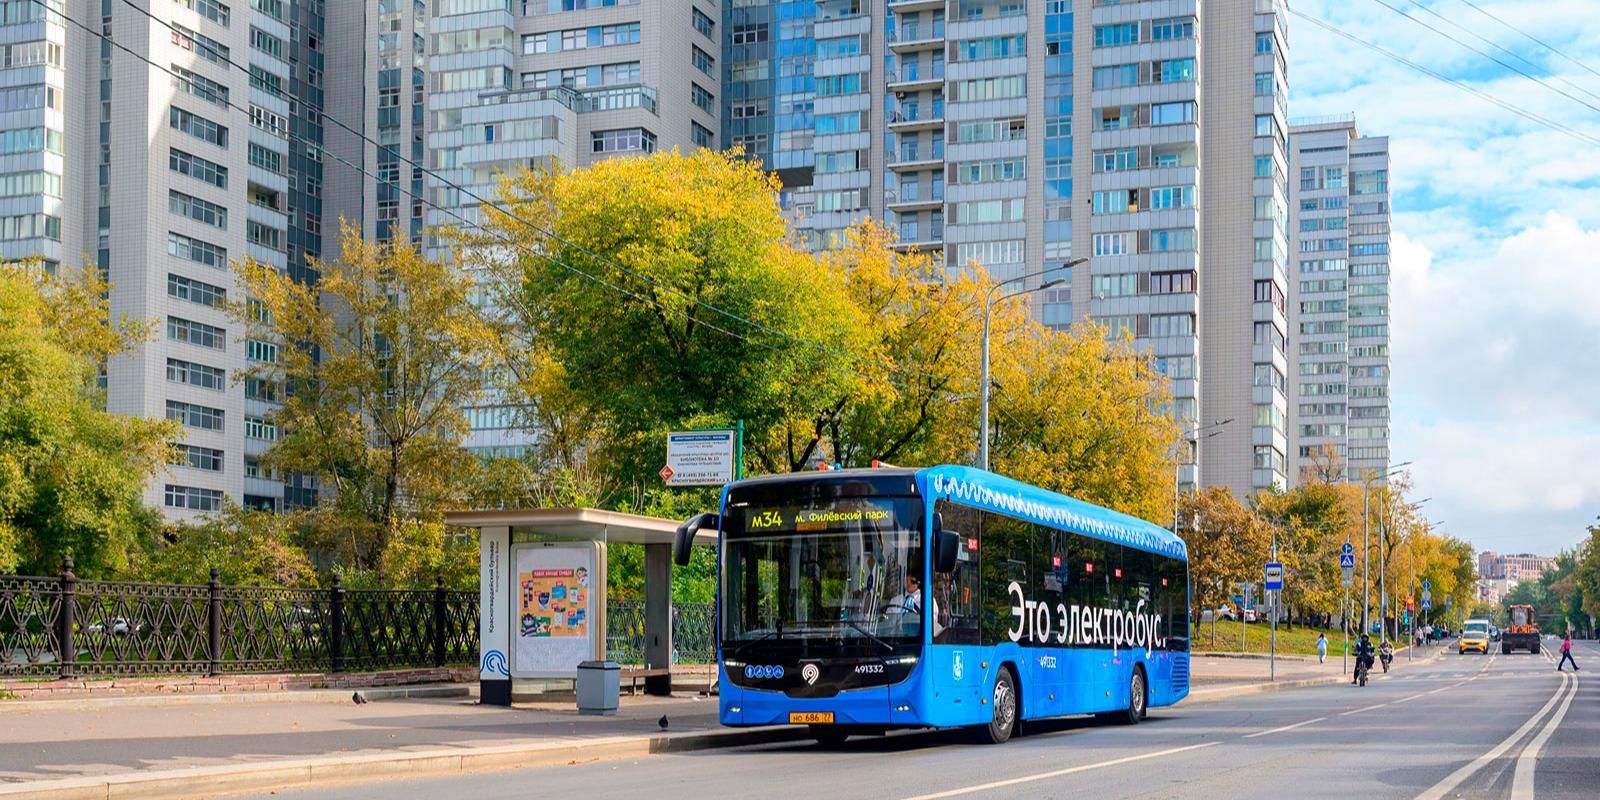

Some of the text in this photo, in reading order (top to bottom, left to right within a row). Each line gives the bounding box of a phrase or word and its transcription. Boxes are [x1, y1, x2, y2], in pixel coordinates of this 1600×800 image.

[808, 510, 862, 522] Филёвский
[865, 511, 889, 520] парк
[1007, 581, 1167, 659] Это электробус.
[854, 665, 884, 673] 491332
[805, 714, 820, 722] 686
